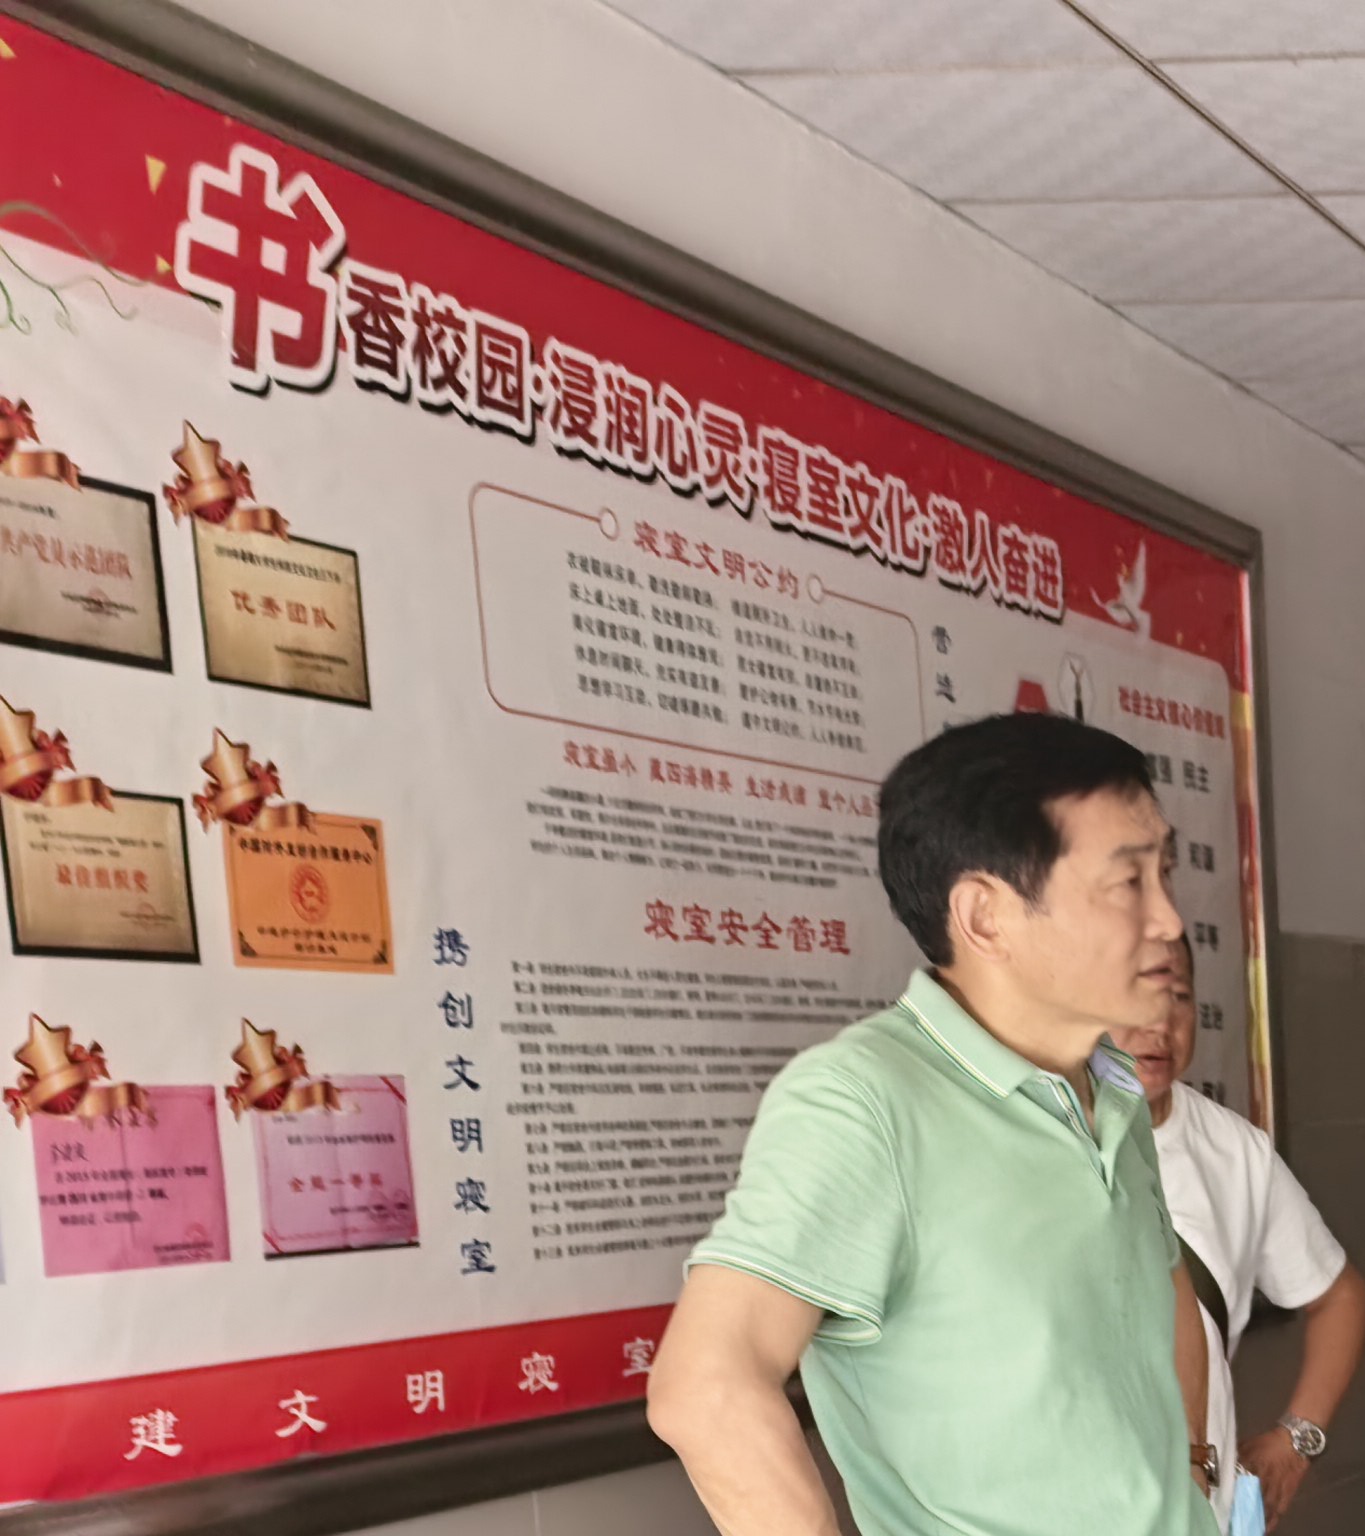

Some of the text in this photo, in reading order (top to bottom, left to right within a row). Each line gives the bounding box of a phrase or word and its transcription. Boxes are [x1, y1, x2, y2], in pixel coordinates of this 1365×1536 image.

[634, 521, 799, 600] 寝室文明公约
[229, 589, 337, 633] 优秀团队
[1182, 760, 1210, 793] 民主
[644, 899, 850, 955] 寝室安全管理
[432, 927, 497, 1277] 携创文明寝室
[124, 1336, 655, 1461] 建文明寝室
